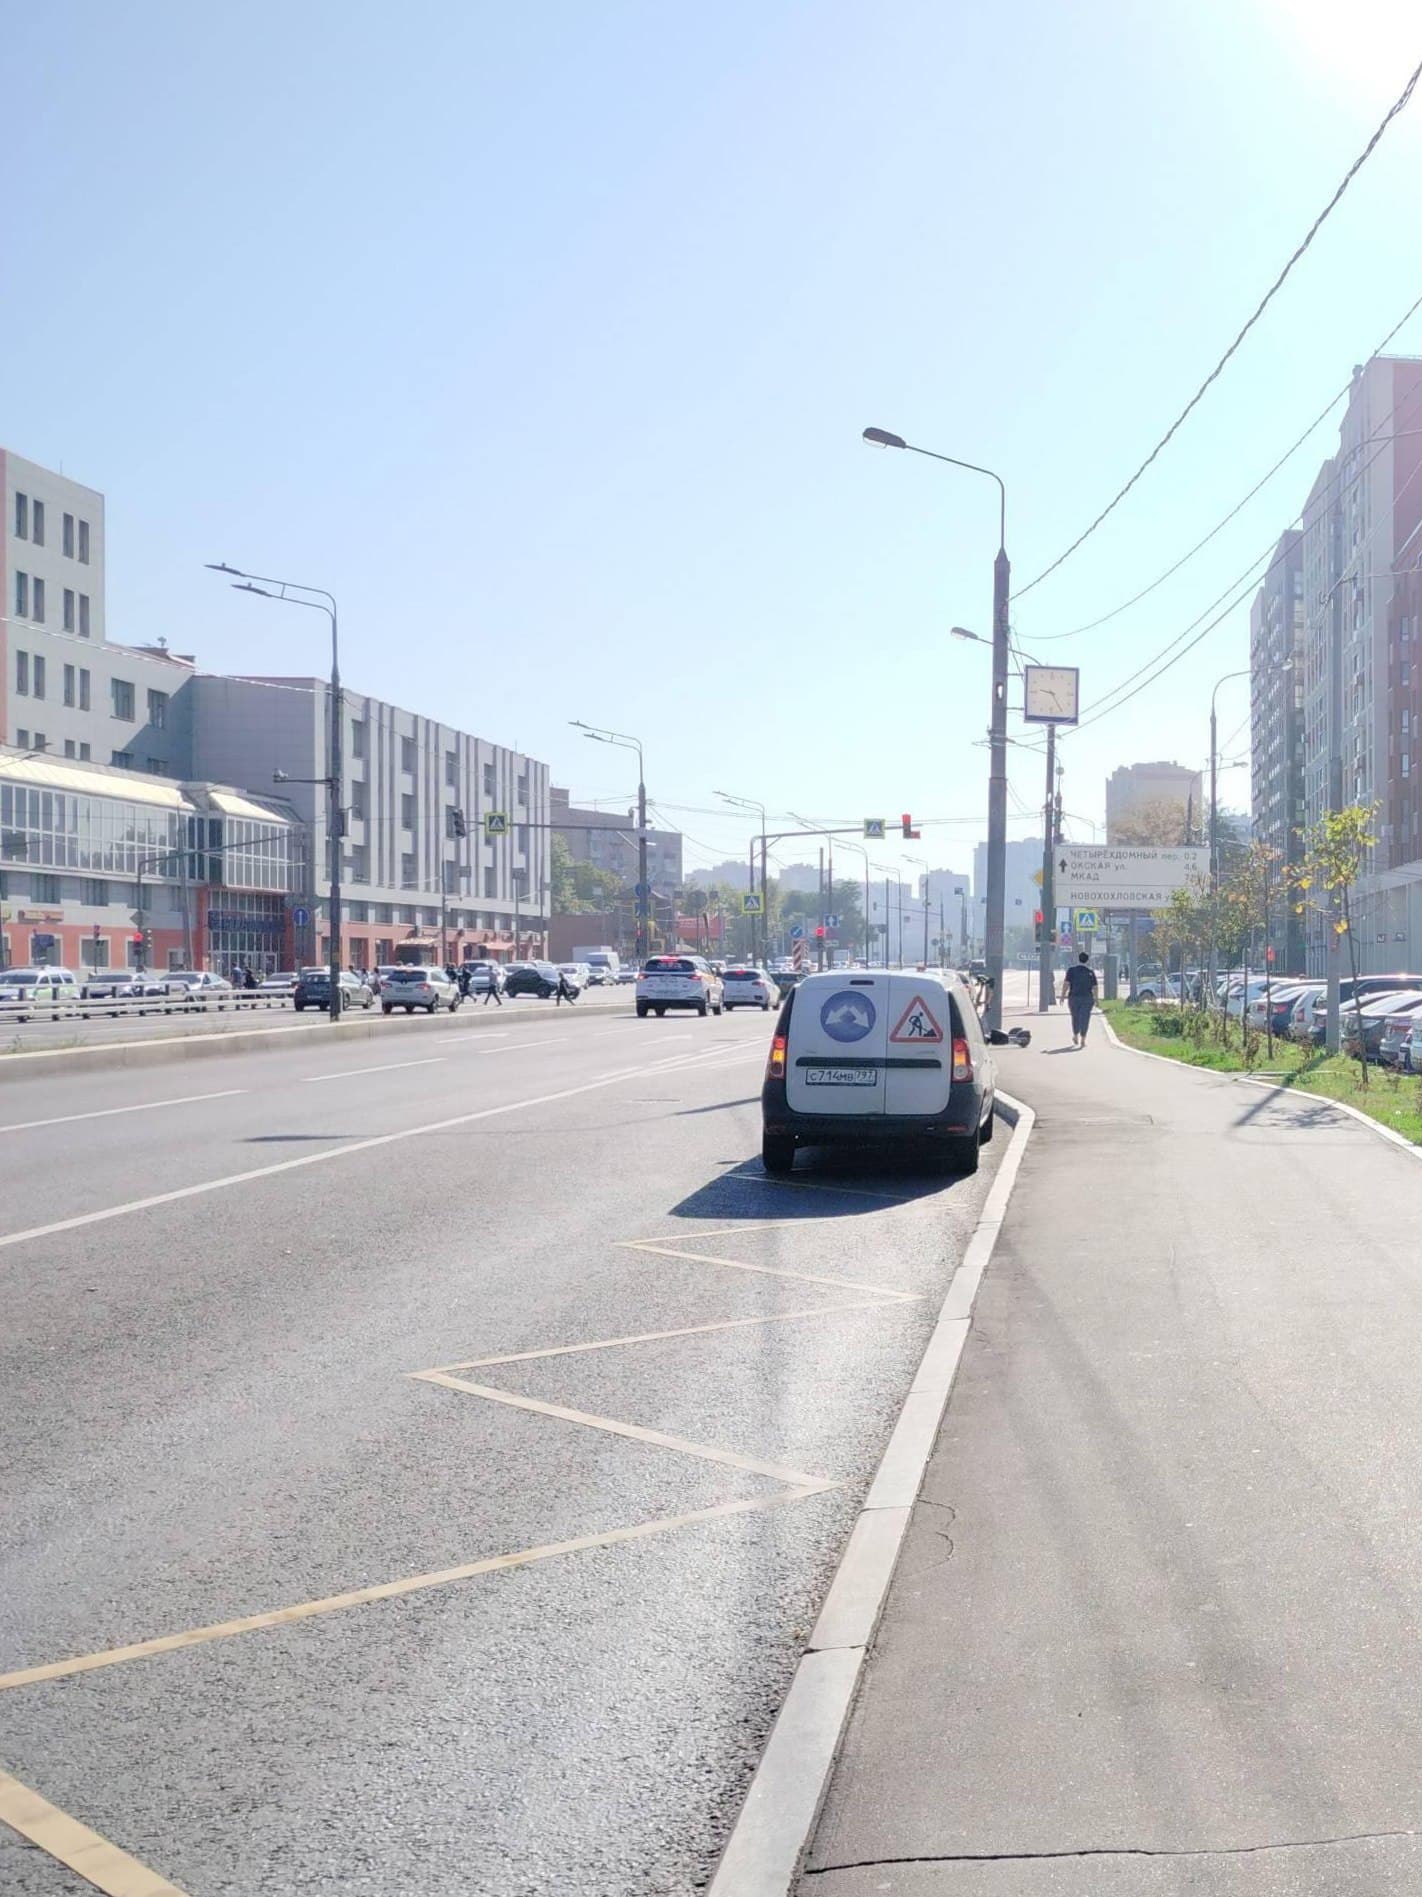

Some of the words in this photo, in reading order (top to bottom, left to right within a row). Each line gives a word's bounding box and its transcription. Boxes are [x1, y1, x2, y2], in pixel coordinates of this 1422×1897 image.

[1071, 862, 1111, 870] ОКСКАЯ
[1071, 873, 1100, 881] МКАД
[1071, 891, 1161, 901] НОВОХОХЛОВСКАЯ
